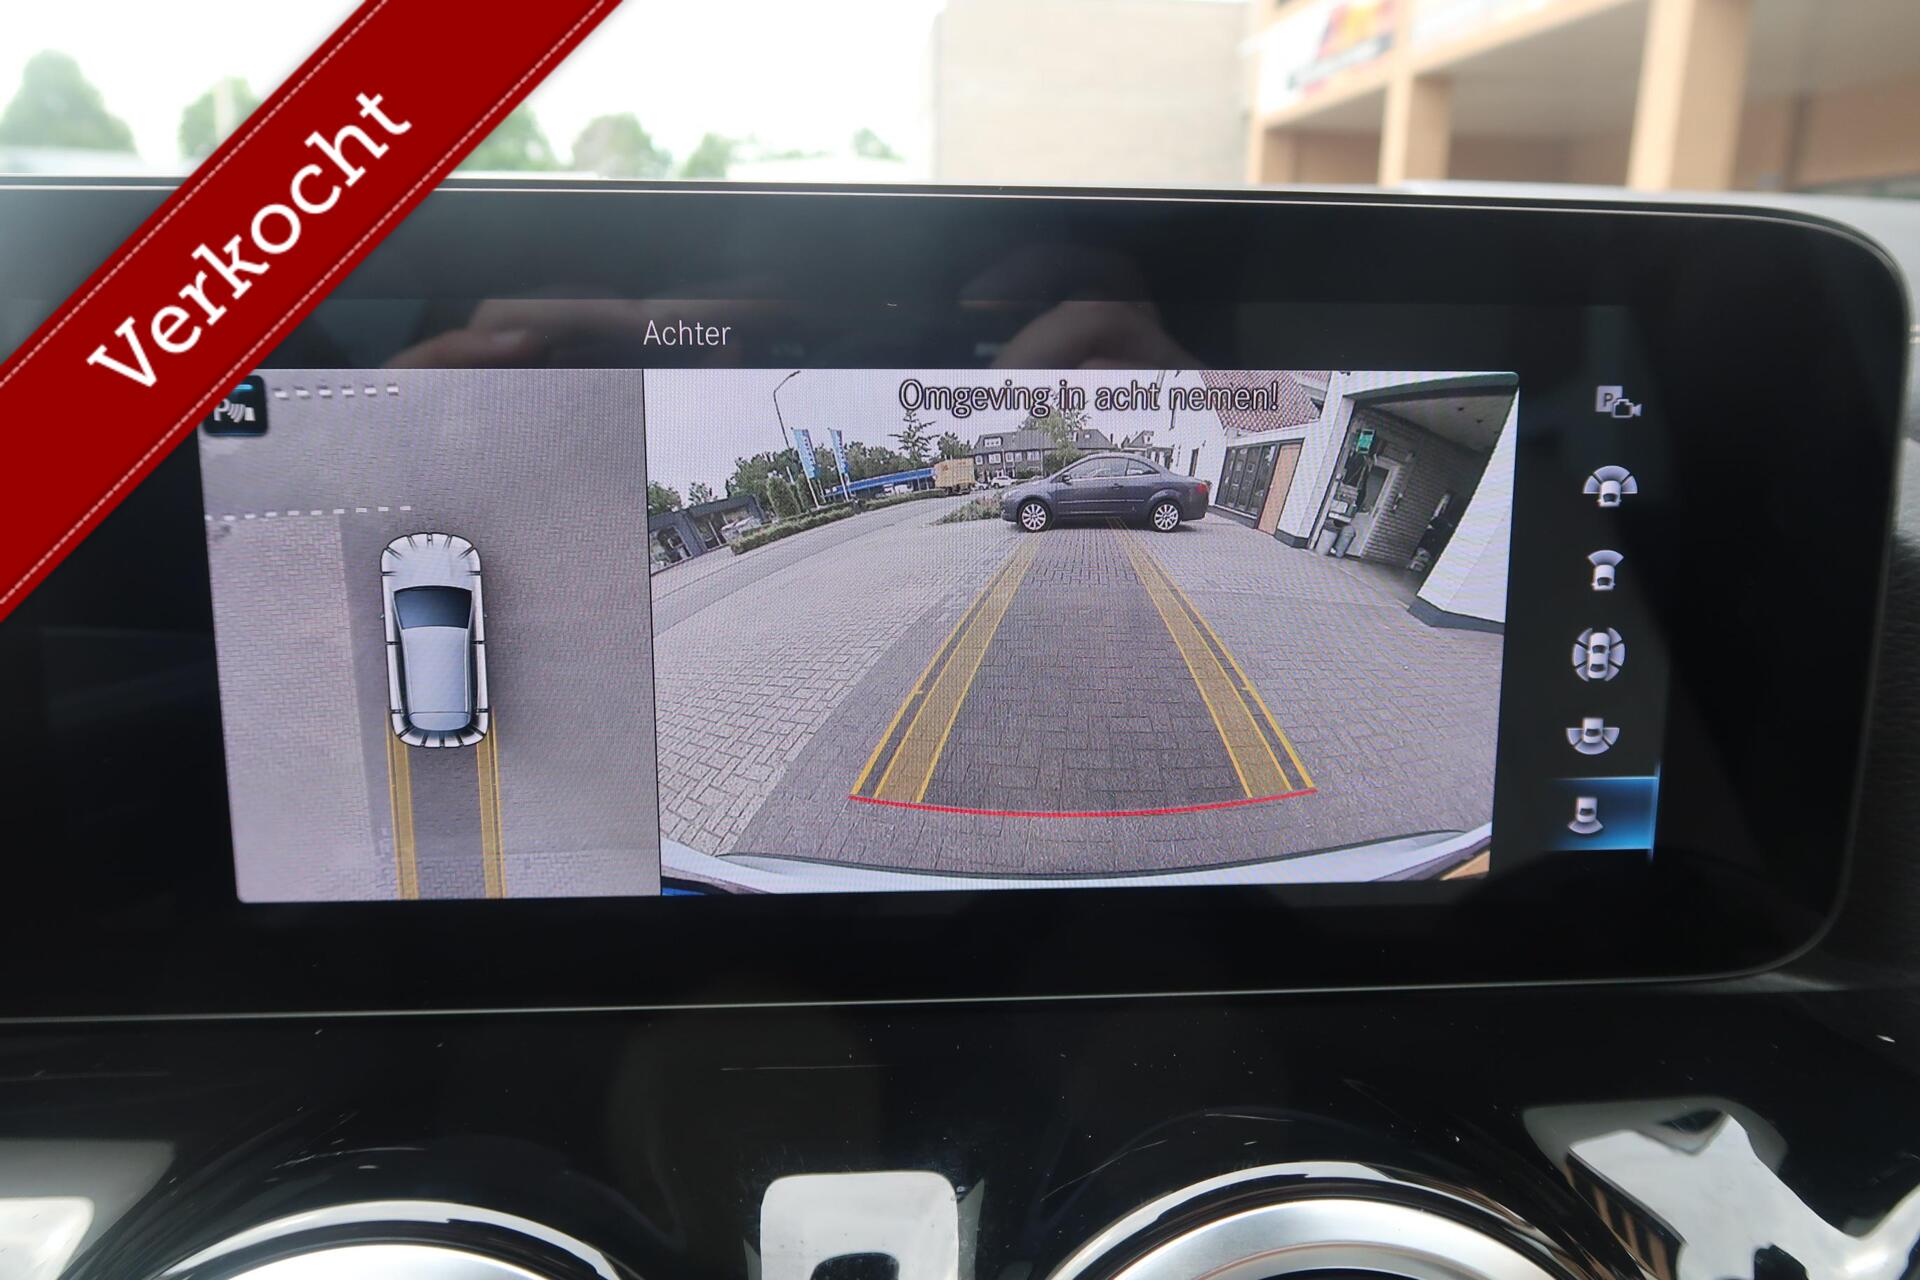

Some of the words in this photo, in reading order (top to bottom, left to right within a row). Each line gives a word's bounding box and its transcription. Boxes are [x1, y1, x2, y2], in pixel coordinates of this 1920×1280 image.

[643, 319, 732, 346] Achter
[900, 378, 1051, 418] Omgeving
[1058, 379, 1086, 411] in
[1094, 379, 1161, 411] acht
[1168, 380, 1280, 411] nemen!
